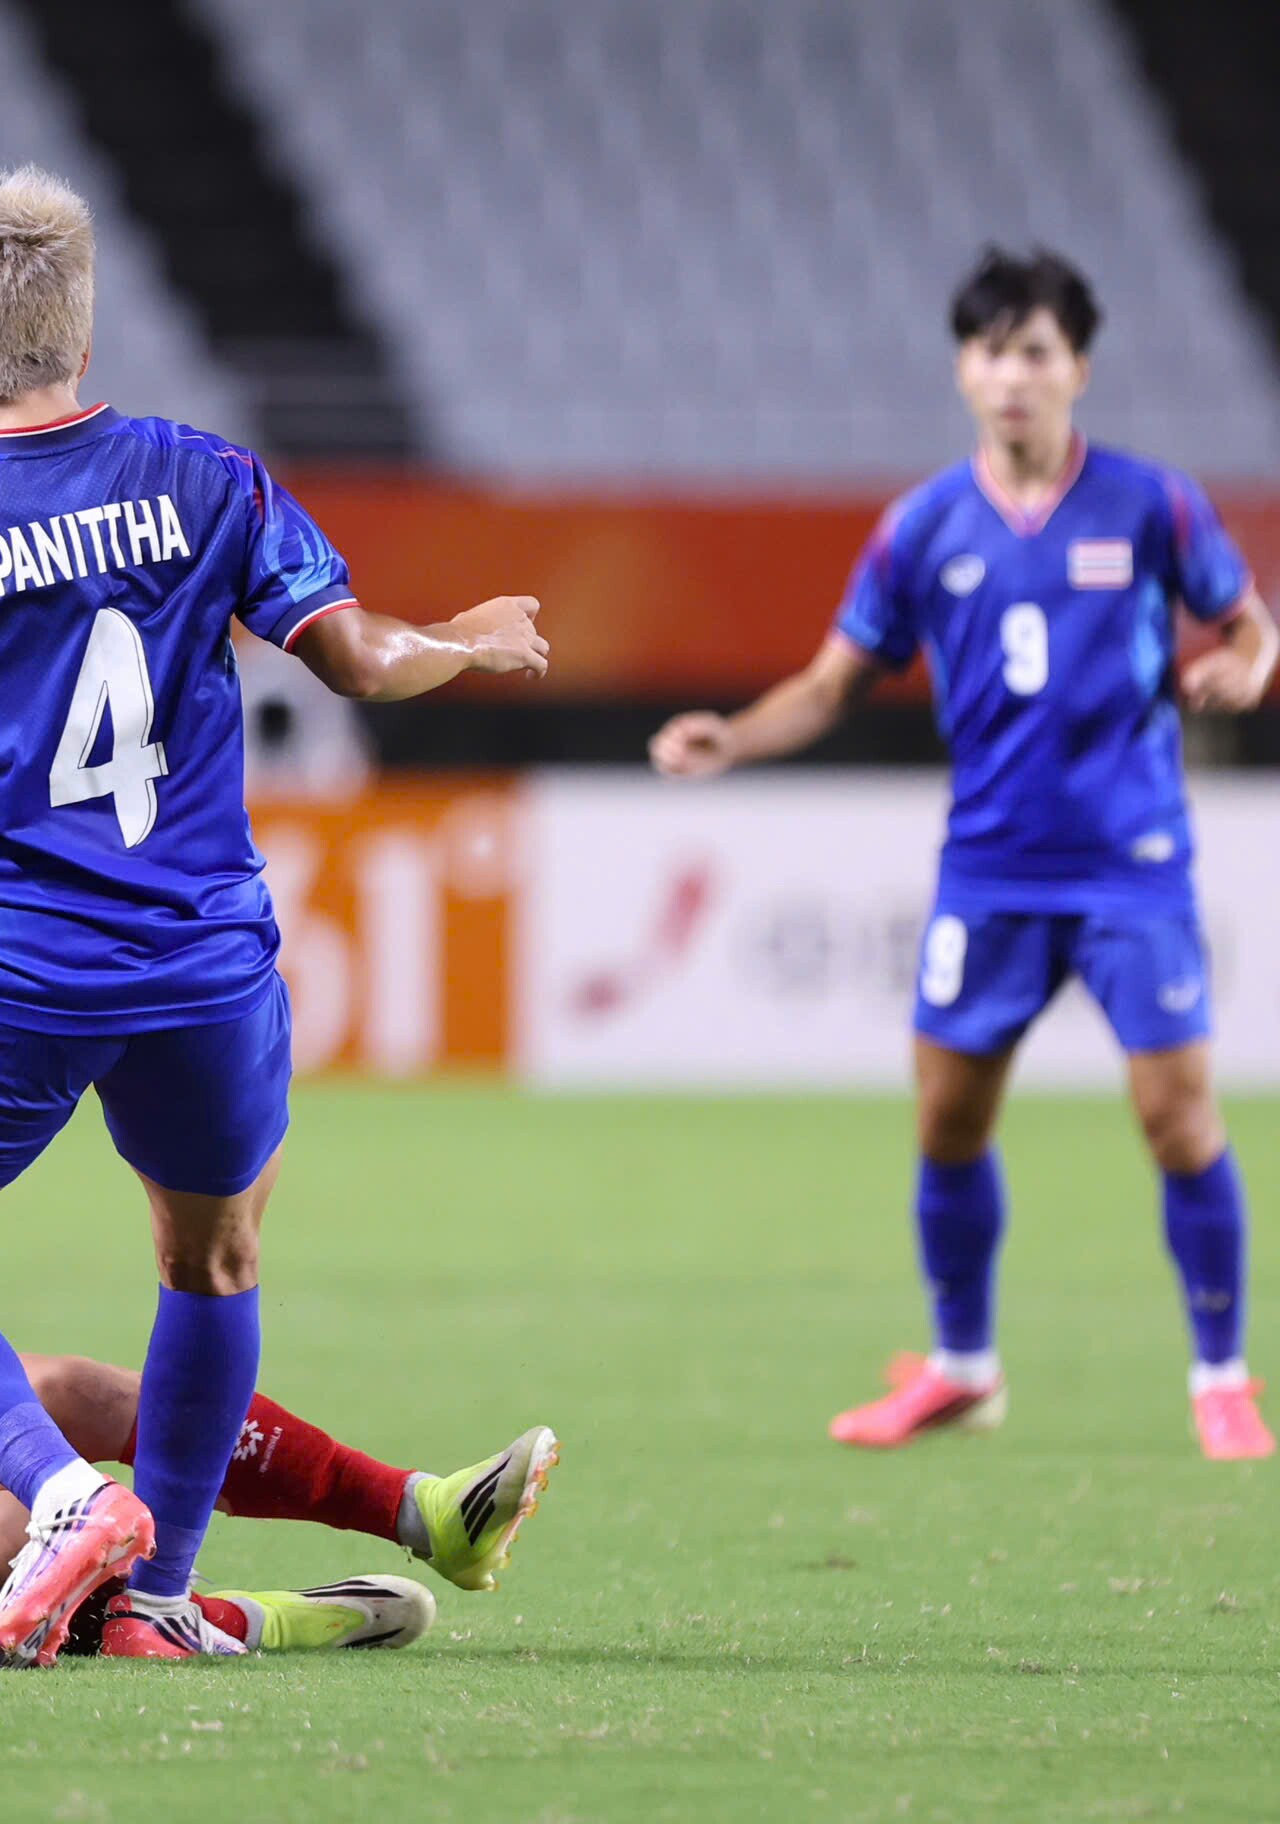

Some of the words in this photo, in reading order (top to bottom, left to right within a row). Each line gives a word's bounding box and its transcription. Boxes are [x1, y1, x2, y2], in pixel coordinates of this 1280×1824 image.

[1000, 601, 1050, 697] 9
[48, 606, 170, 850] 4
[920, 913, 968, 1008] 9
